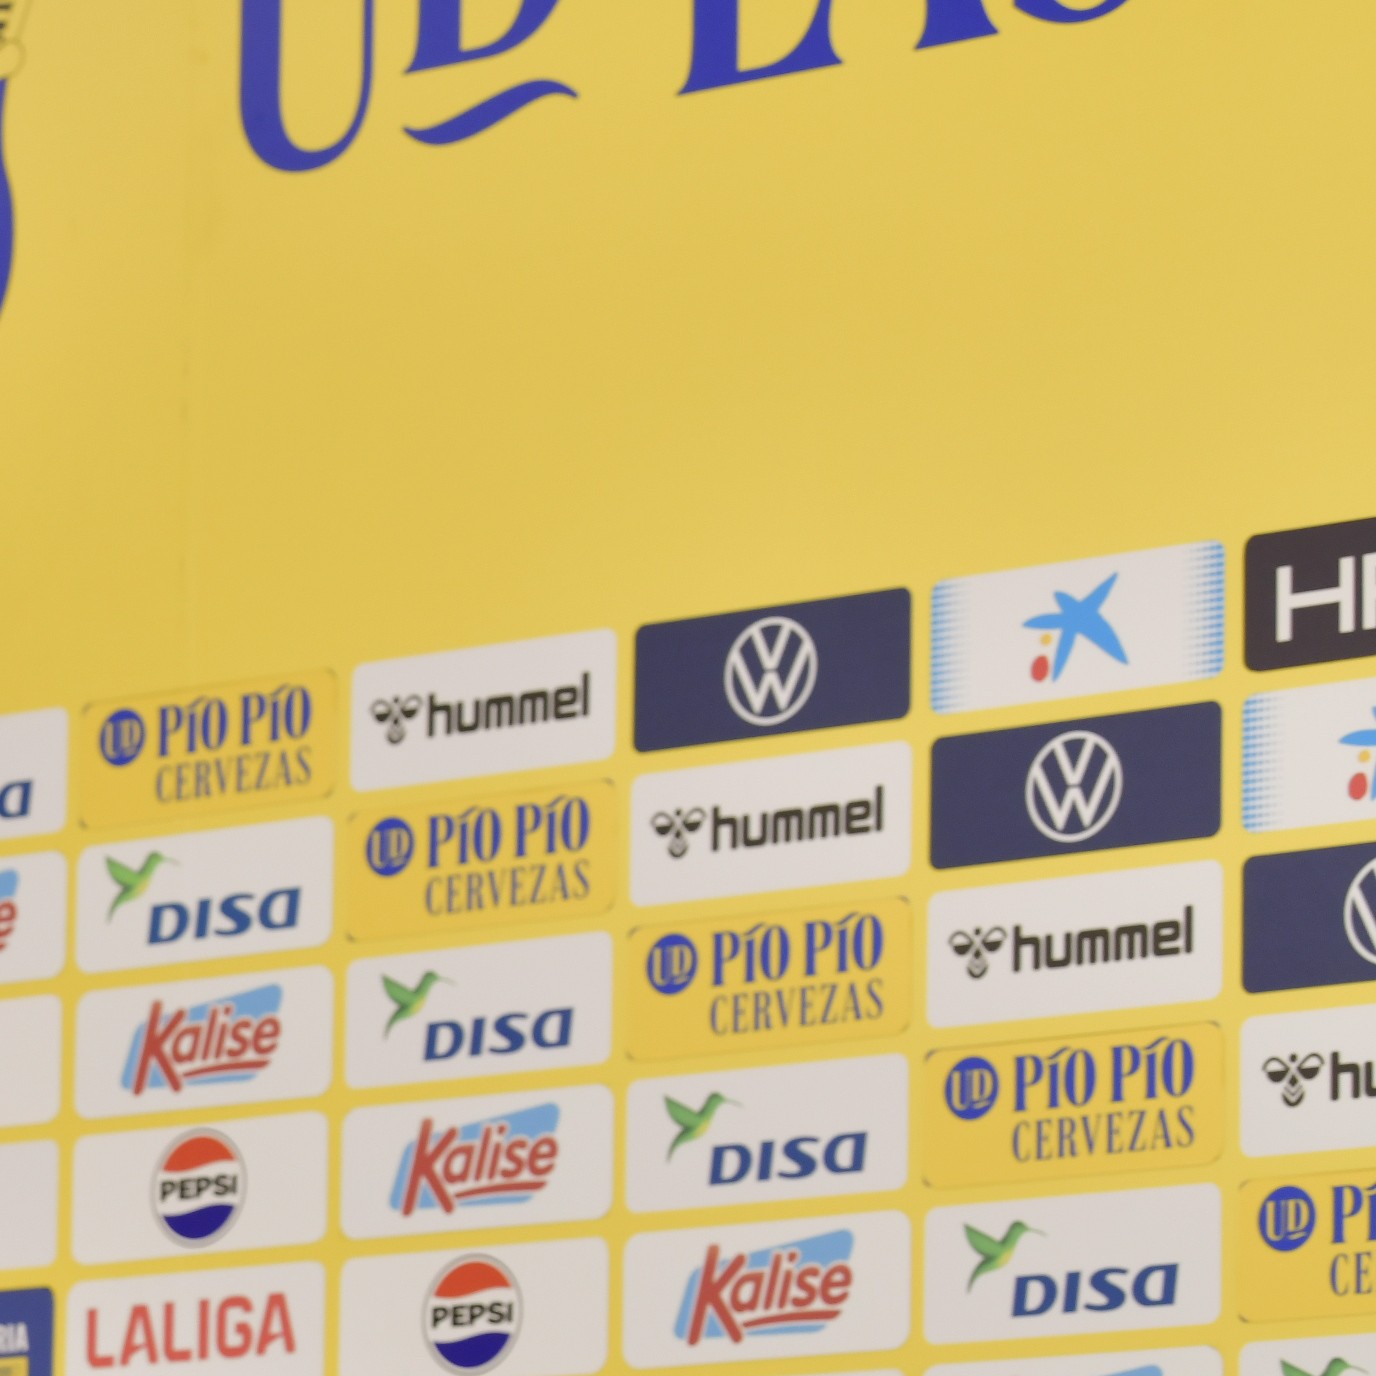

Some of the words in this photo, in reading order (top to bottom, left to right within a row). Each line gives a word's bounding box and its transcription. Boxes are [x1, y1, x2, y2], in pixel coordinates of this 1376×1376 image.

[105, 719, 140, 758] UD
[159, 700, 228, 756] PÍO
[242, 688, 311, 745] PÍO
[427, 672, 589, 736] hummel
[156, 750, 311, 800] CERVEZAS
[372, 827, 409, 868] UD
[429, 809, 501, 867] PÍO
[516, 799, 589, 857] PÍO
[711, 785, 882, 851] hummel
[425, 863, 589, 912] CERVEZAS
[653, 944, 692, 986] UD
[713, 926, 790, 985] PÍO
[806, 915, 883, 975] PÍO
[1013, 905, 1192, 971] hummel
[710, 982, 883, 1032] CERVEZAS
[133, 999, 282, 1097] Kalise
[951, 1068, 993, 1111] UD
[1015, 1049, 1096, 1111] PÍO
[1112, 1038, 1193, 1101] PÍO
[401, 1117, 559, 1216] Kalise
[1012, 1108, 1194, 1160] CERVEZAS
[160, 1174, 236, 1200] PEPSI
[1266, 1199, 1310, 1242] UD
[432, 1301, 512, 1327] PEPSI
[687, 1243, 853, 1346] Kalise
[87, 1293, 295, 1367] LALIGA
